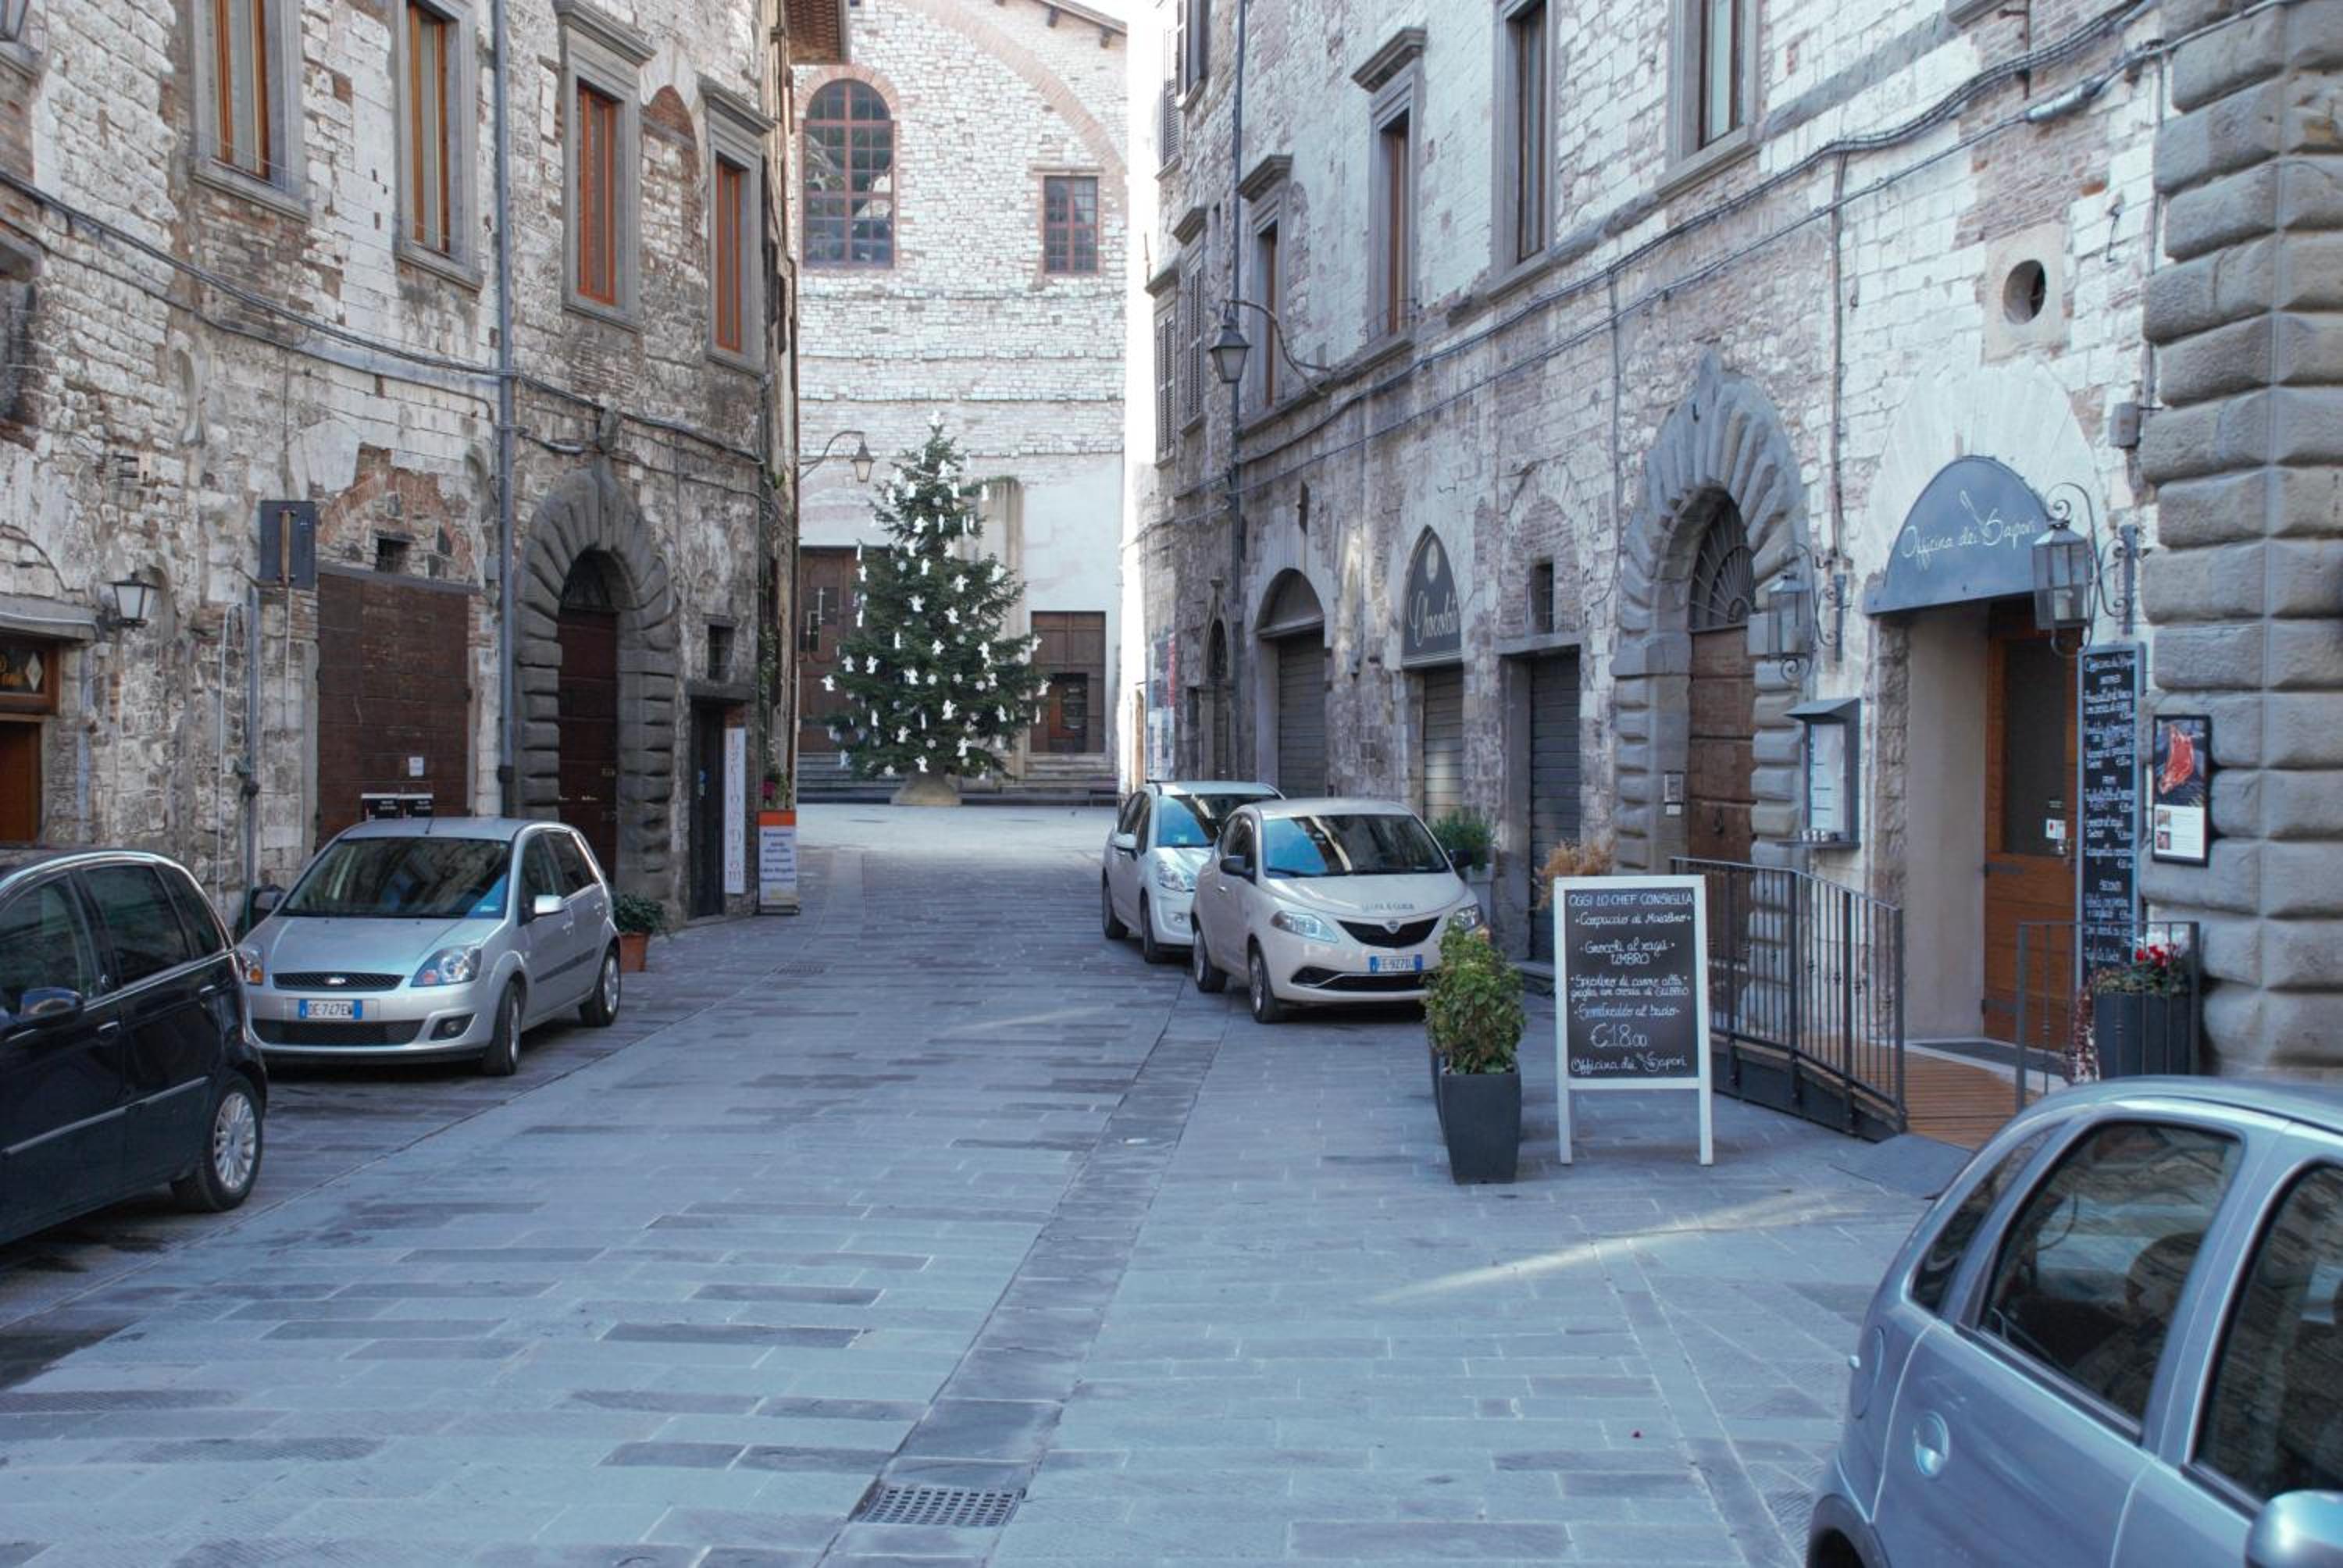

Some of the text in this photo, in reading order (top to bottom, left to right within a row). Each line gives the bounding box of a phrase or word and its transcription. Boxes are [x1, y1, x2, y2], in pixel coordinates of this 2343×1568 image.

[1901, 524, 1953, 571] Officina
[1982, 508, 2037, 551] Sapori
[1568, 893, 1694, 907] OGGI LO CHEF CONSIGLIA
[1580, 911, 1628, 928] Carpaccio
[1627, 936, 1639, 951] al
[1571, 1057, 1619, 1075] Officina
[1642, 1051, 1688, 1073] Sapori
